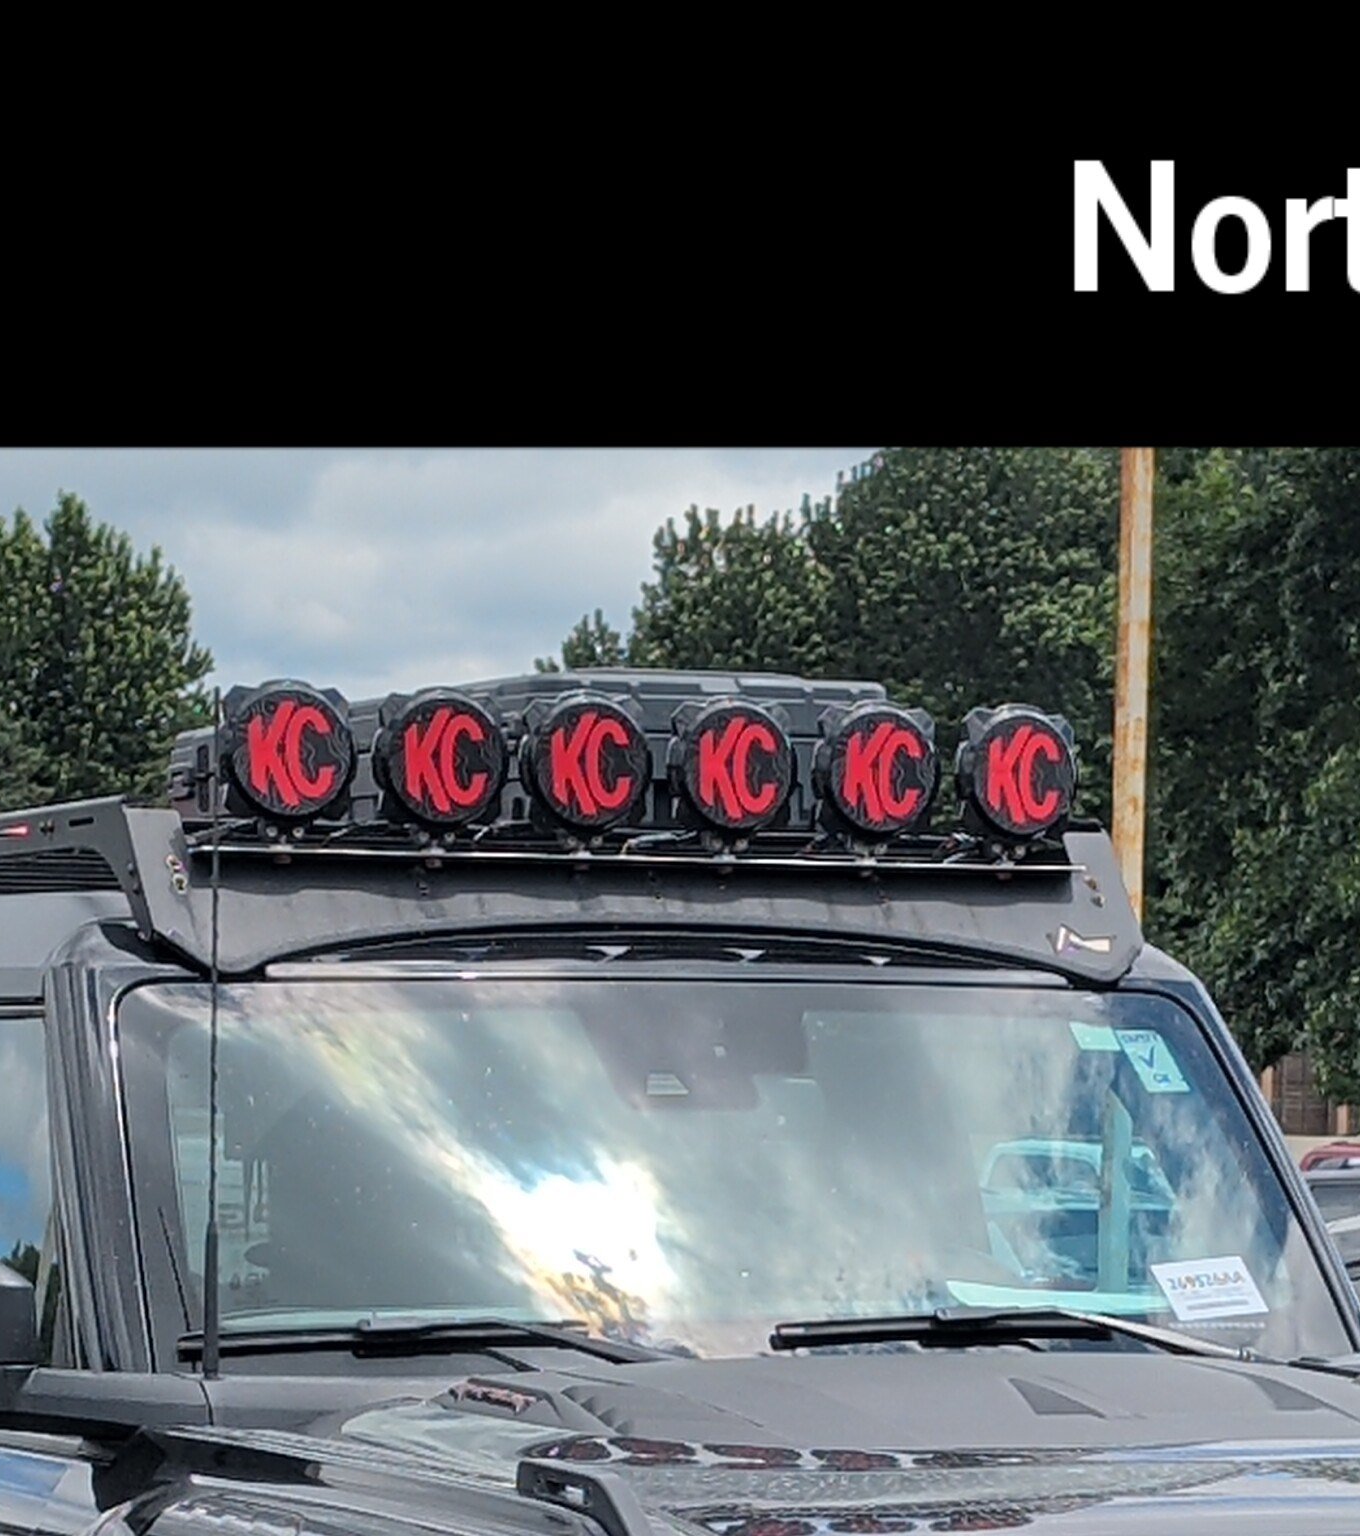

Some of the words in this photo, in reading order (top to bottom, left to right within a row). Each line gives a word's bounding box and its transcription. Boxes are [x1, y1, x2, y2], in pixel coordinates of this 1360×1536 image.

[249, 700, 336, 806] KC
[405, 707, 488, 813] KC
[551, 713, 633, 815] KC
[700, 717, 779, 820] KC
[842, 722, 924, 822] KC
[988, 725, 1062, 824] KC
